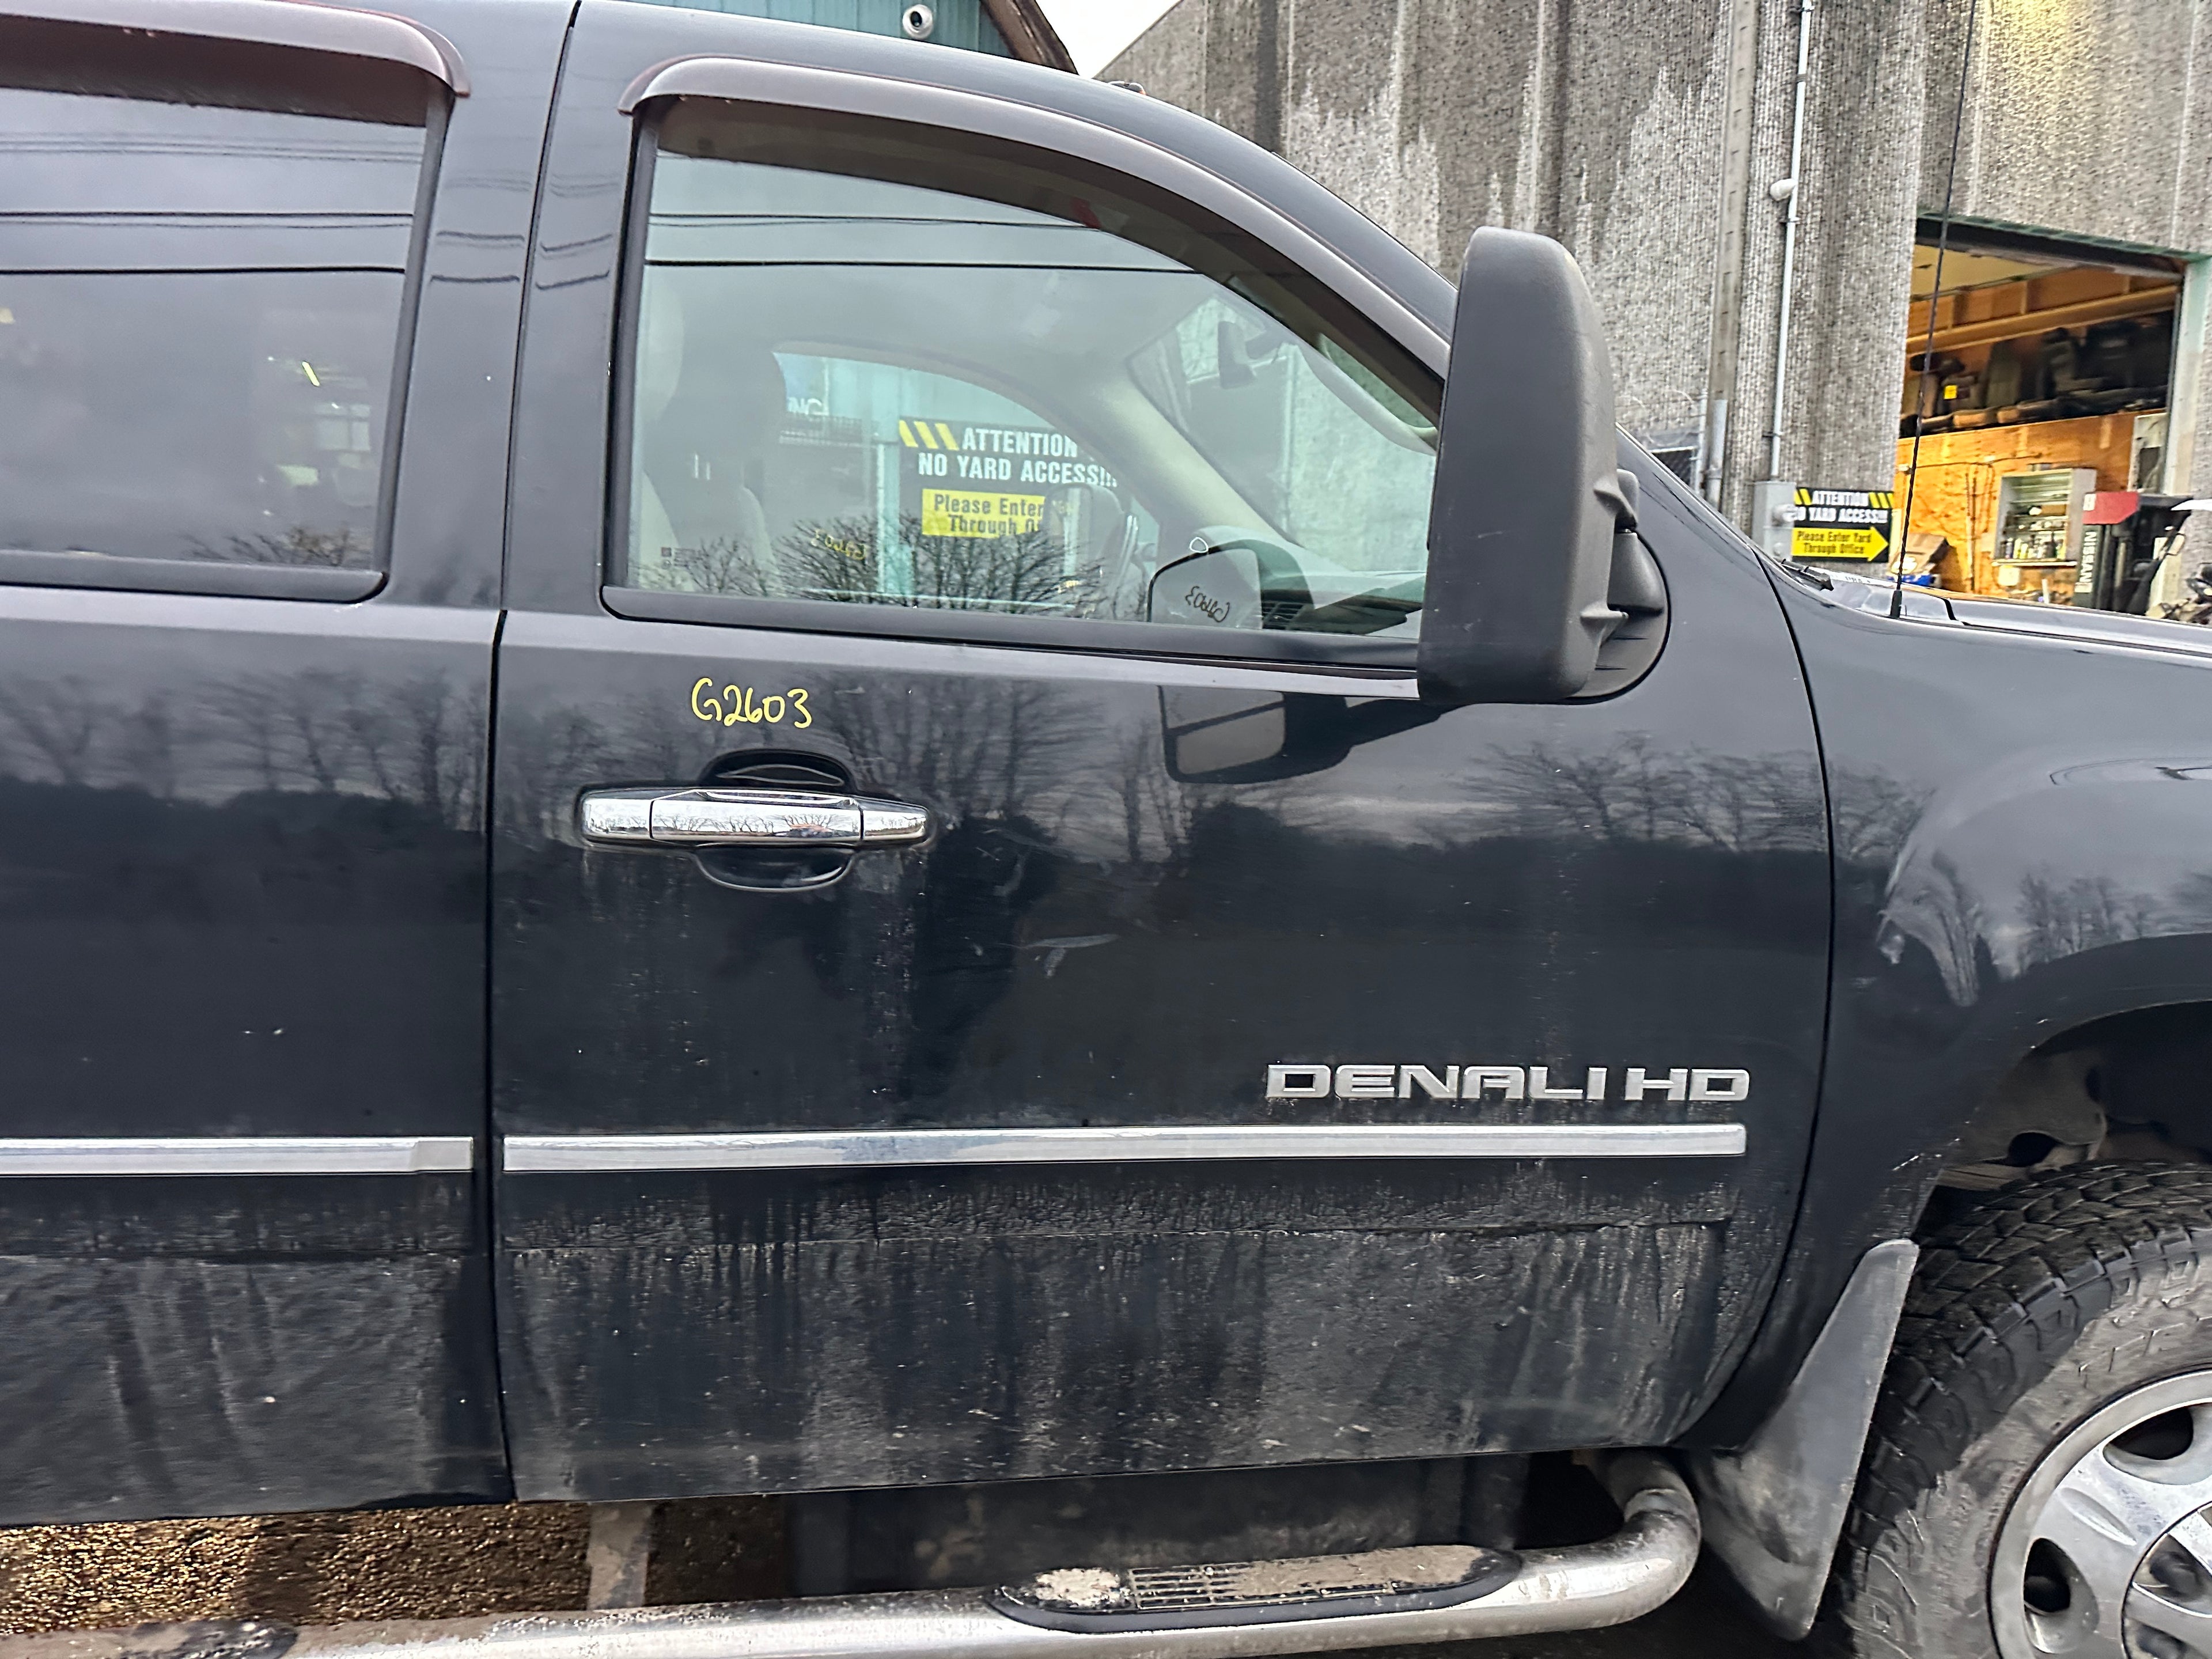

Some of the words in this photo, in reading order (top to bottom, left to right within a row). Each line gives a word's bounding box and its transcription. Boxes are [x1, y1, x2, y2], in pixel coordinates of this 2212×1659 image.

[962, 427, 1078, 458] ATTENTION
[919, 452, 948, 476] NO
[958, 455, 1012, 480] YARD
[934, 494, 991, 515] Please
[1000, 497, 1044, 518] Enter
[1812, 491, 1869, 506] ATTENTION
[948, 514, 1017, 535] Through
[1809, 507, 1836, 522] YARD
[1797, 530, 1825, 542] Please
[1827, 531, 1851, 543] Enter
[1854, 532, 1872, 543] Yard
[1804, 543, 1836, 555] Through
[1839, 544, 1865, 554] Office
[2079, 531, 2097, 582] NISSAN
[691, 677, 812, 729] G2603
[1266, 1064, 1608, 1101] DENALI
[1625, 1067, 1750, 1102] HD
